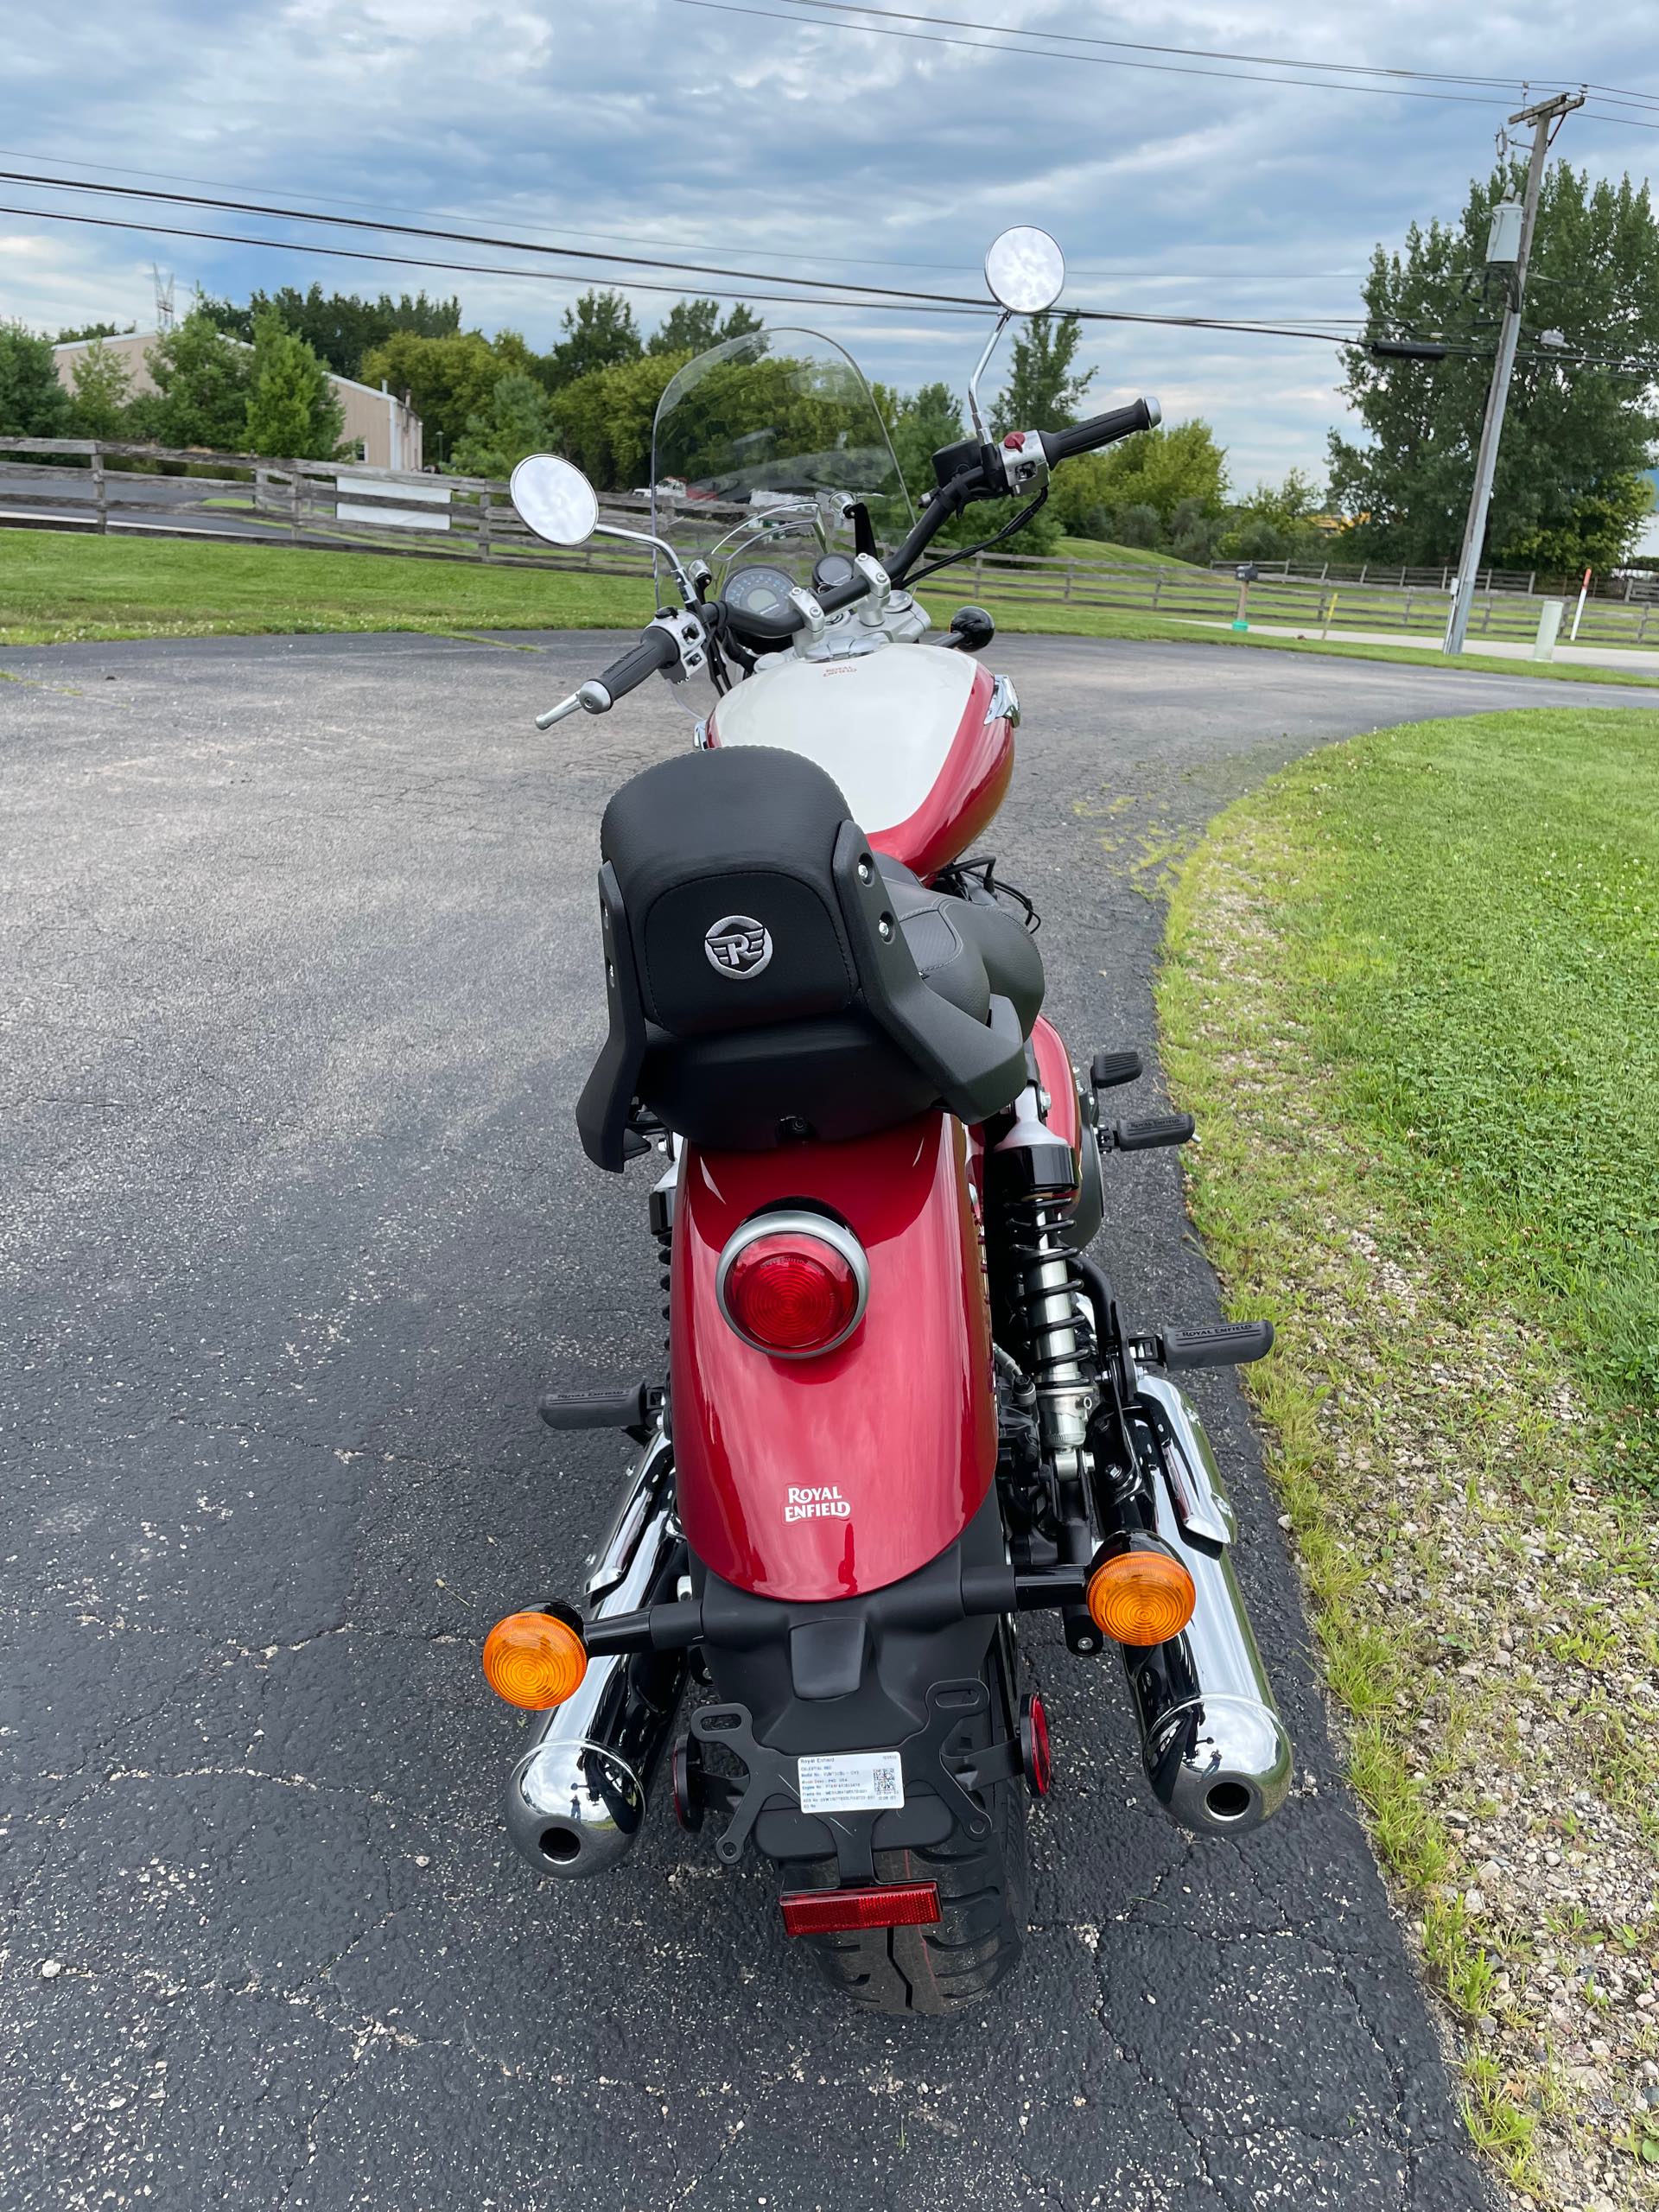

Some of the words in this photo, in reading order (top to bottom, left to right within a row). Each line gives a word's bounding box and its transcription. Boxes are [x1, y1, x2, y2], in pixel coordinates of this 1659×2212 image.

[1215, 1325, 1252, 1334] ENFIELD
[787, 1485, 842, 1504] ROYAL
[785, 1501, 851, 1522] ENFIELD
